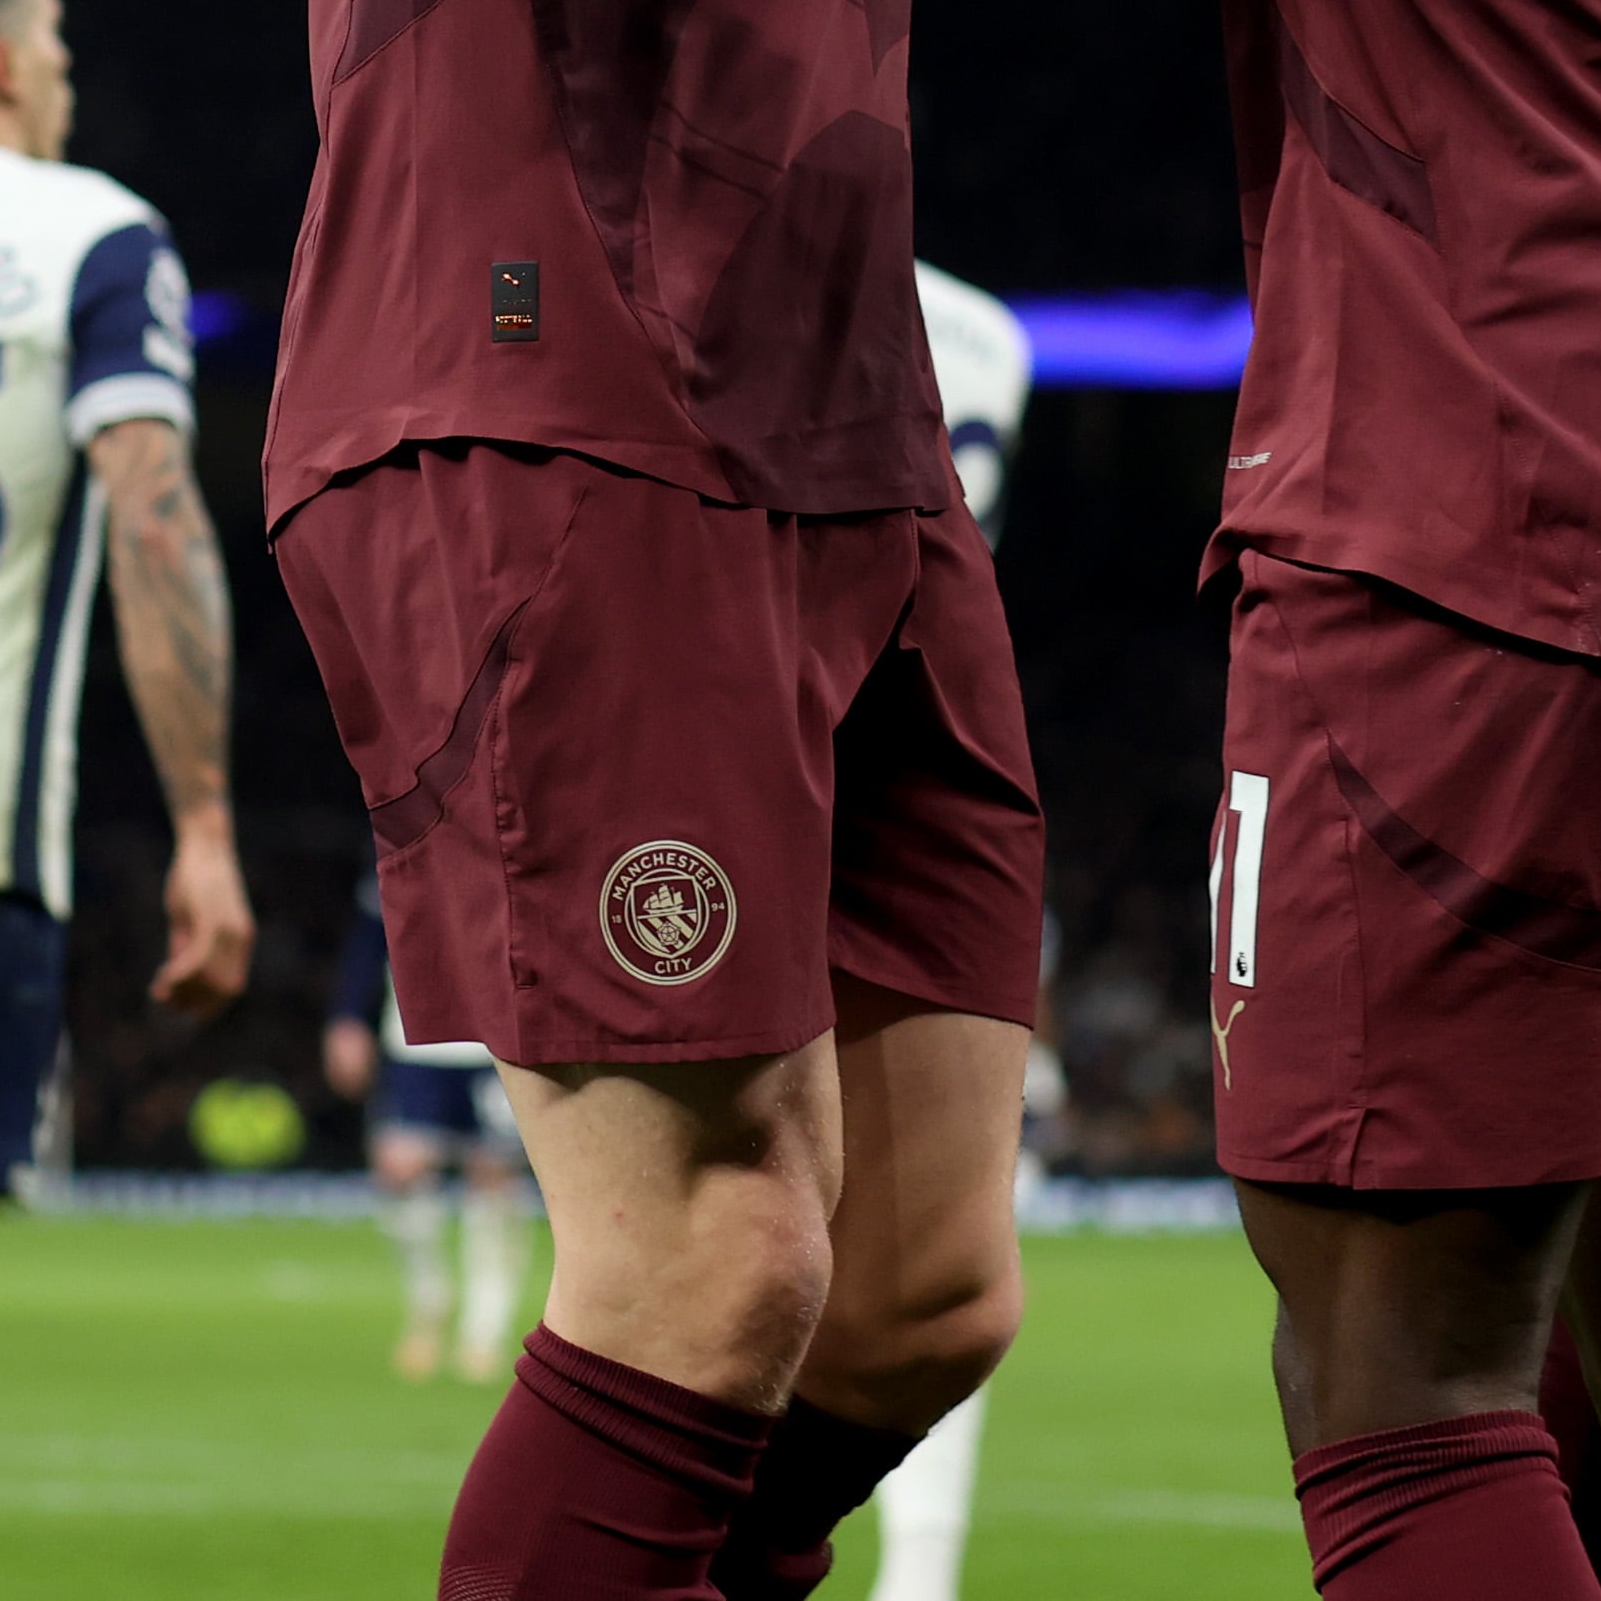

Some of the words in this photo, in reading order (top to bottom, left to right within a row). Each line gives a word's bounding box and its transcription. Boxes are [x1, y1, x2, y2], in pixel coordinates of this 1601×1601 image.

[612, 852, 717, 901] MANCHESTER
[711, 902, 726, 912] 94
[654, 957, 692, 974] CITY
